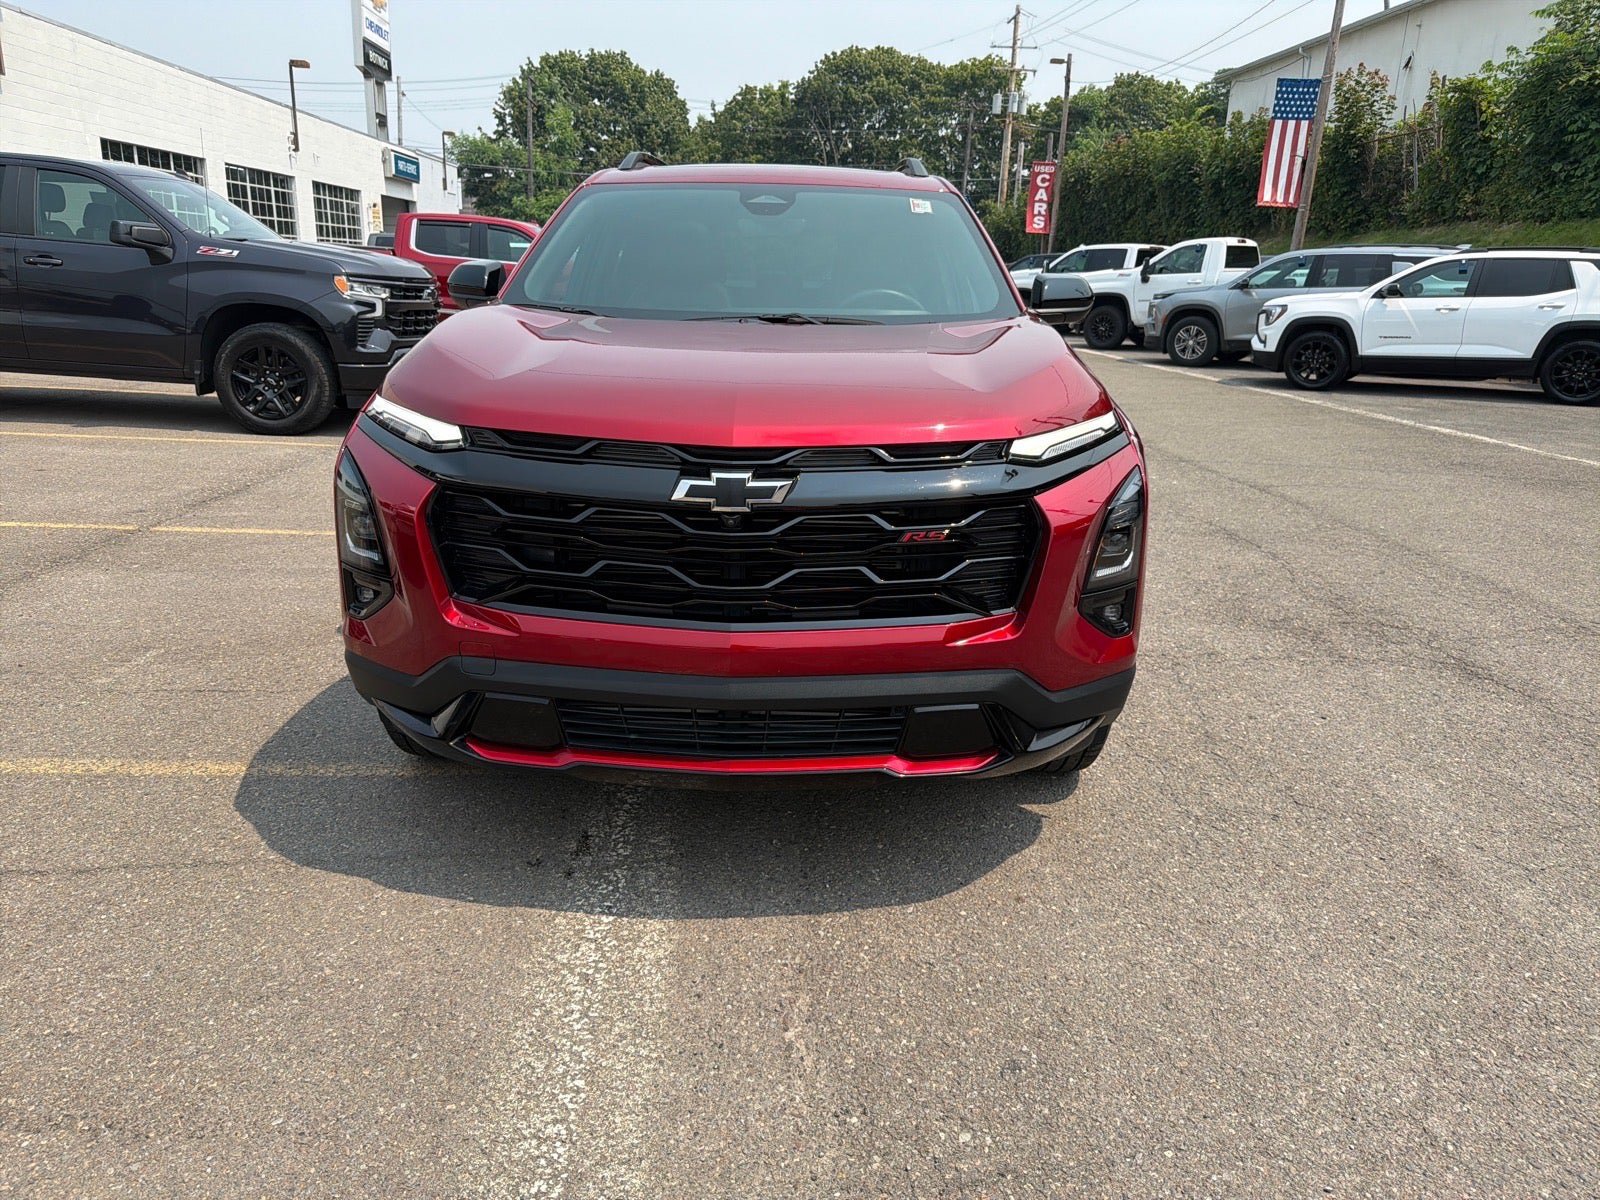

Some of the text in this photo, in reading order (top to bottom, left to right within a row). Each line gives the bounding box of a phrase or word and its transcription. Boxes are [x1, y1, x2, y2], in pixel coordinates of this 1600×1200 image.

[365, 16, 389, 41] CHEVROLET
[1034, 164, 1055, 173] USED
[1032, 173, 1051, 229] CARS
[196, 245, 240, 258] Z71
[899, 530, 947, 543] RS
